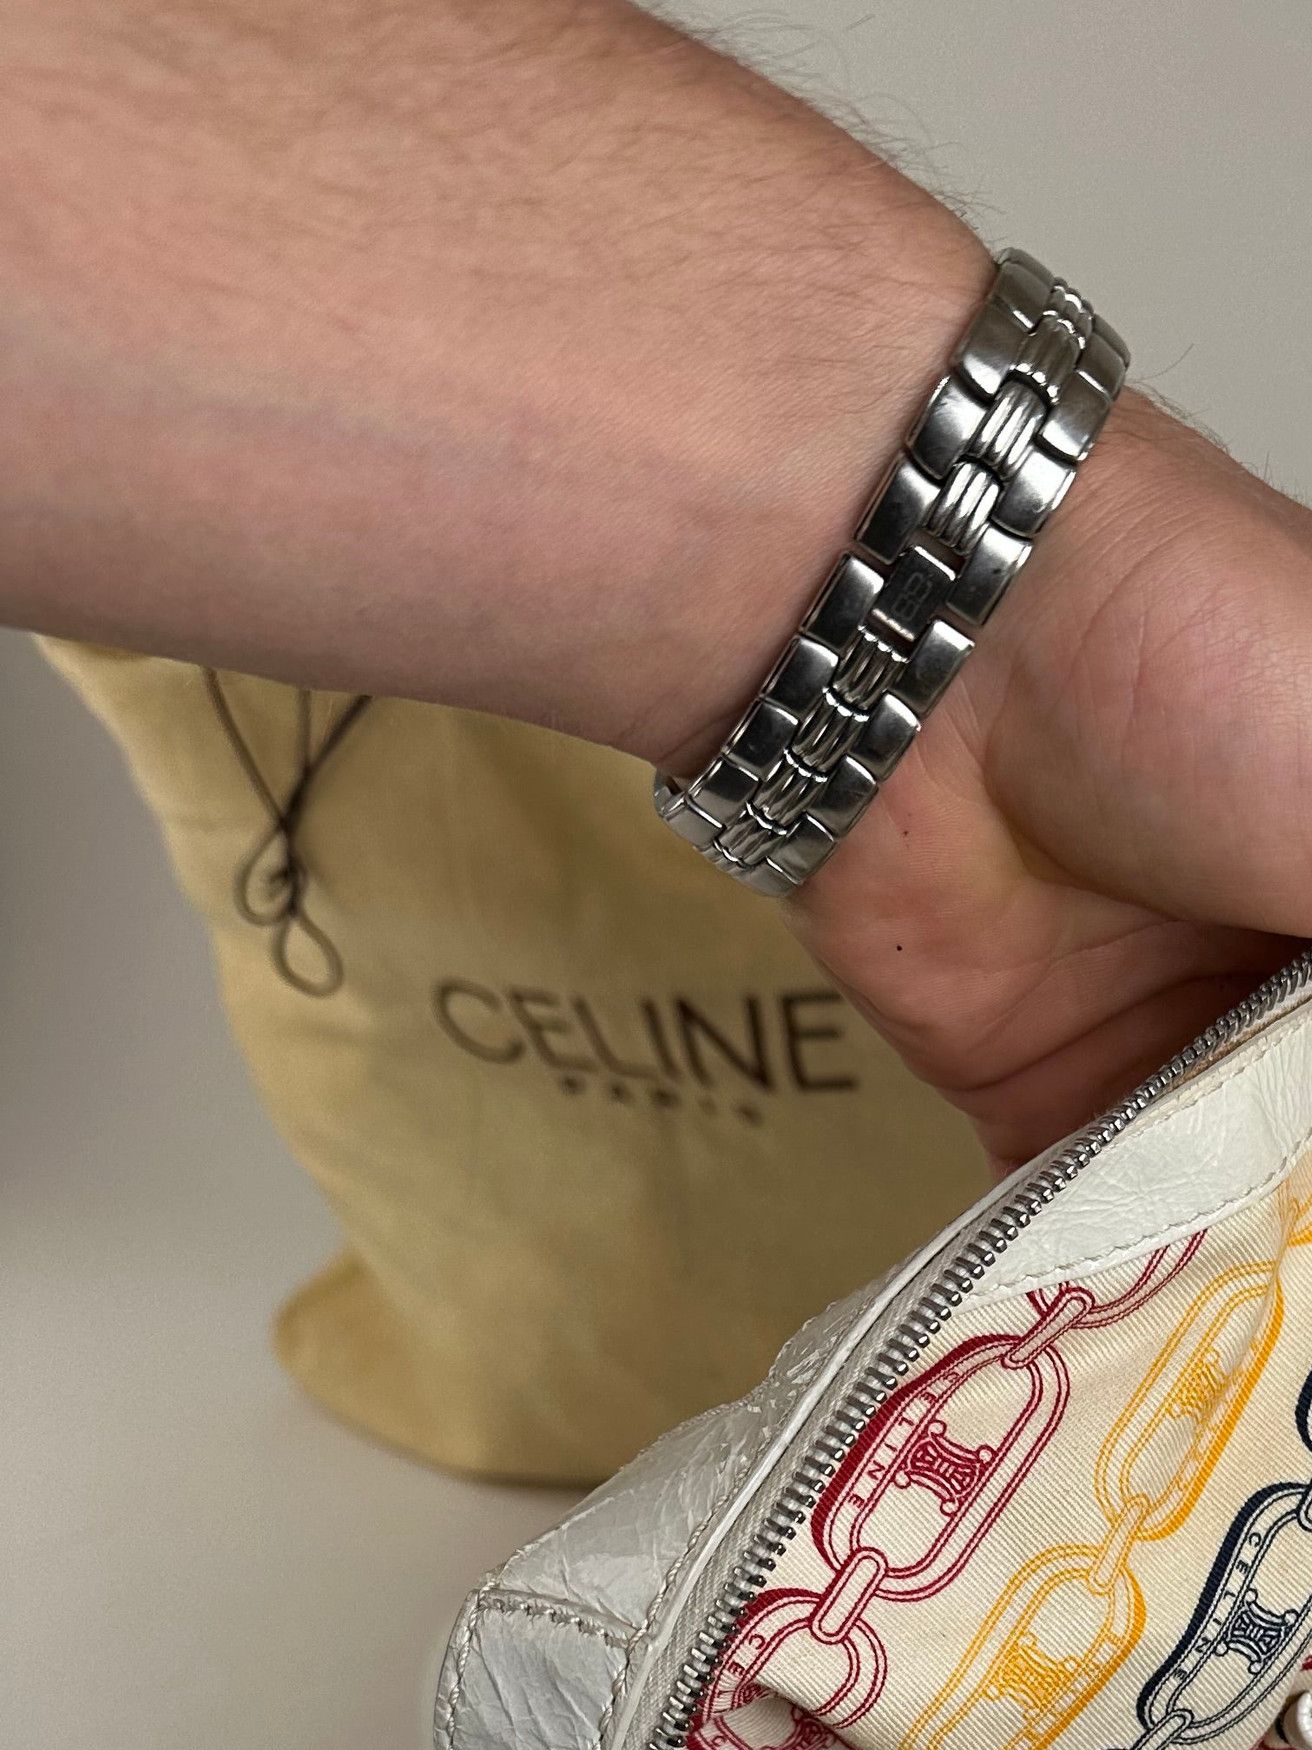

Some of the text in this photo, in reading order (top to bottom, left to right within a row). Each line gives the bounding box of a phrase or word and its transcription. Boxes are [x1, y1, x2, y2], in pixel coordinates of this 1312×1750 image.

[432, 976, 858, 1092] CELINE
[849, 1371, 961, 1510] CELINE
[1173, 1531, 1262, 1681] CELINE
